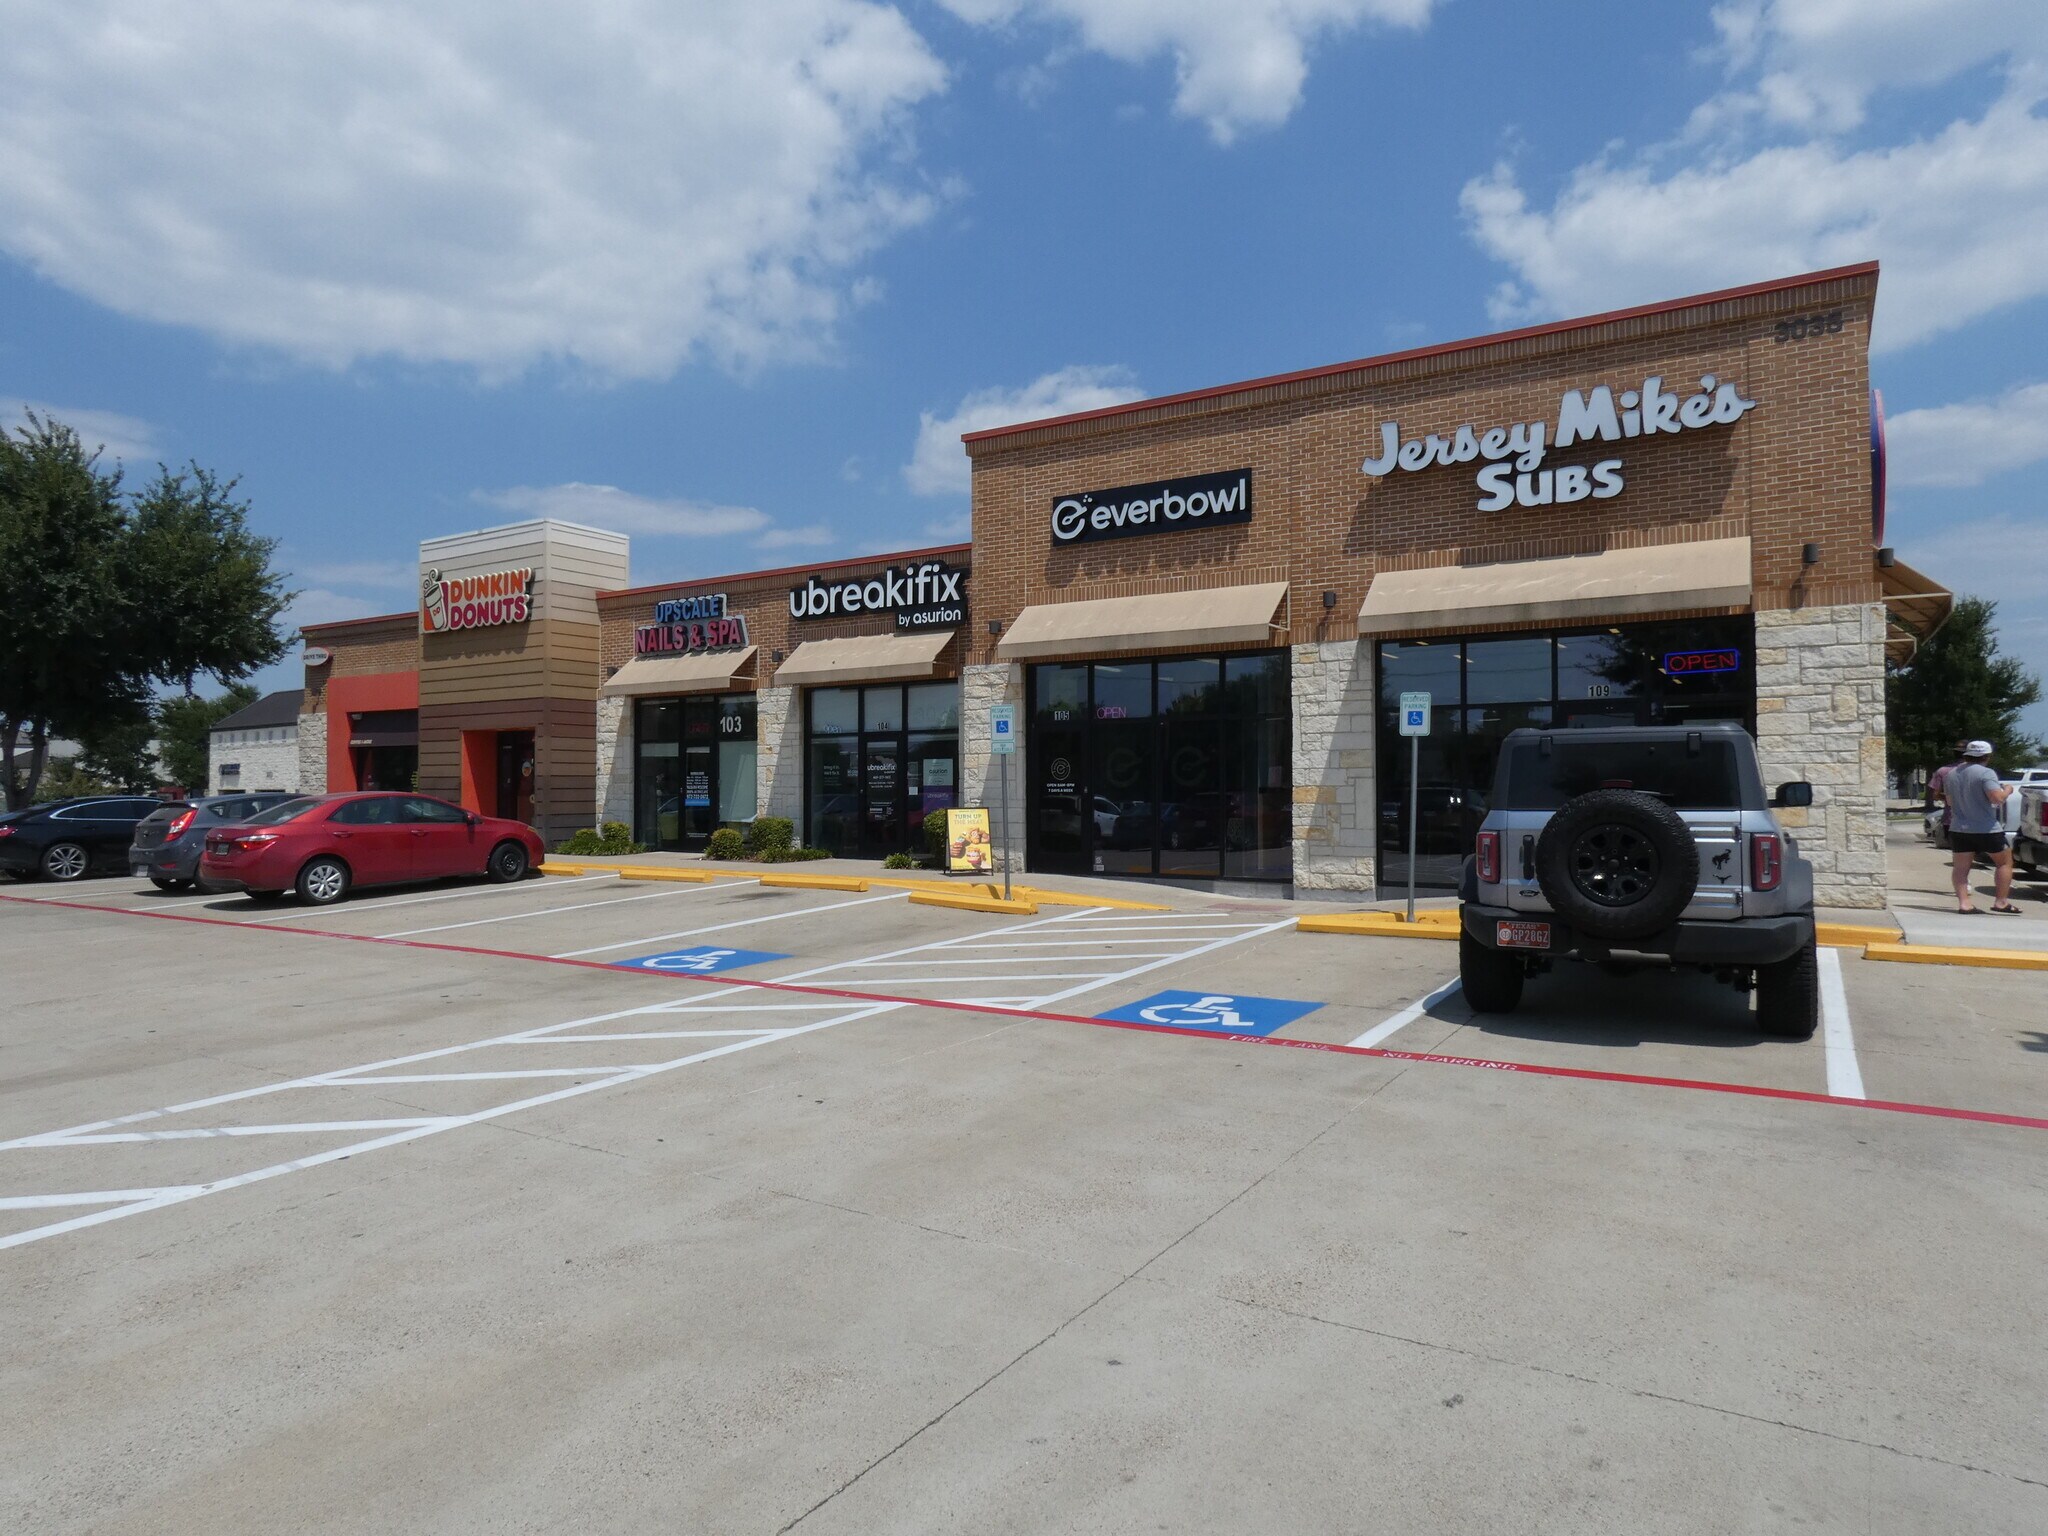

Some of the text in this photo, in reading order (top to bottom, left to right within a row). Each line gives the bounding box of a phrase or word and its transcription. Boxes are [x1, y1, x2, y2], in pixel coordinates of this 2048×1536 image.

[1774, 310, 1845, 342] 3035
[1361, 373, 1757, 477] Jersey Mike's
[1090, 477, 1247, 530] everbowl
[449, 567, 530, 603] DUNKIN'
[789, 563, 961, 618] ubreakifix
[449, 595, 527, 629] DONUTS
[655, 596, 720, 623] UPSCALE
[898, 606, 962, 627] by asurion
[634, 618, 742, 654] NAILS & SPA
[1669, 652, 1735, 672] OPEN
[1589, 685, 1610, 697] 109
[719, 716, 742, 733] 103
[1055, 710, 1069, 720] 105
[1096, 706, 1127, 719] OPEN
[877, 721, 889, 731] 104
[1424, 1054, 1518, 1071] PARKING
